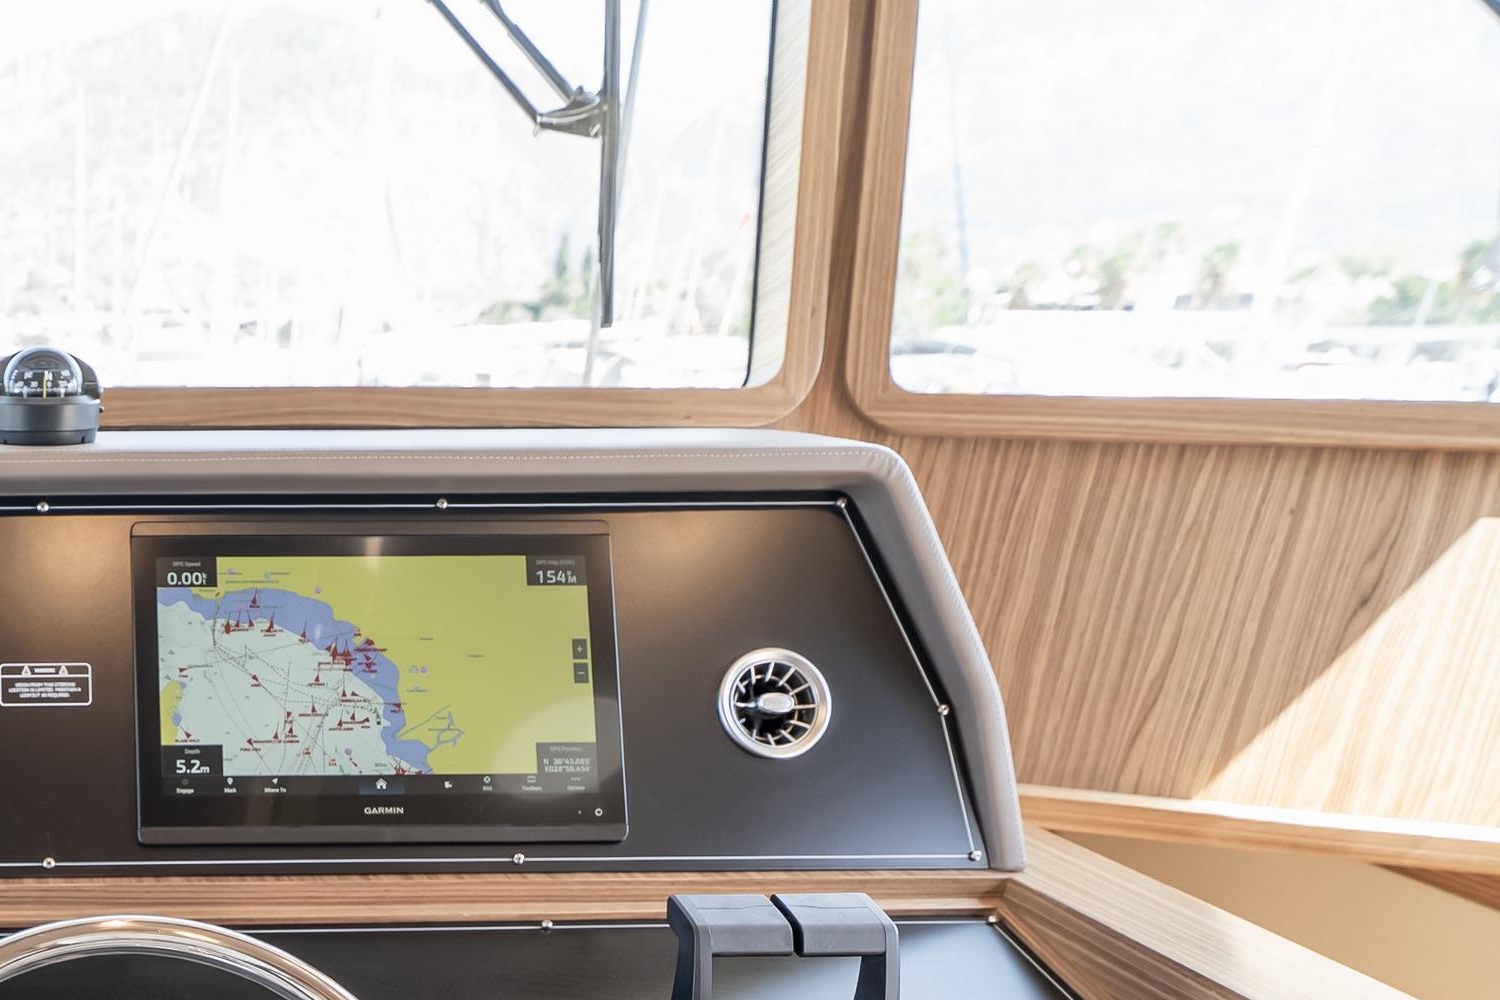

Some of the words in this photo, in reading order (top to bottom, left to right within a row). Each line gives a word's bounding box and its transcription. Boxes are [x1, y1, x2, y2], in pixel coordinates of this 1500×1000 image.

[167, 572, 202, 585] 0.00
[536, 569, 567, 584] 154
[363, 806, 404, 815] GARMIN
